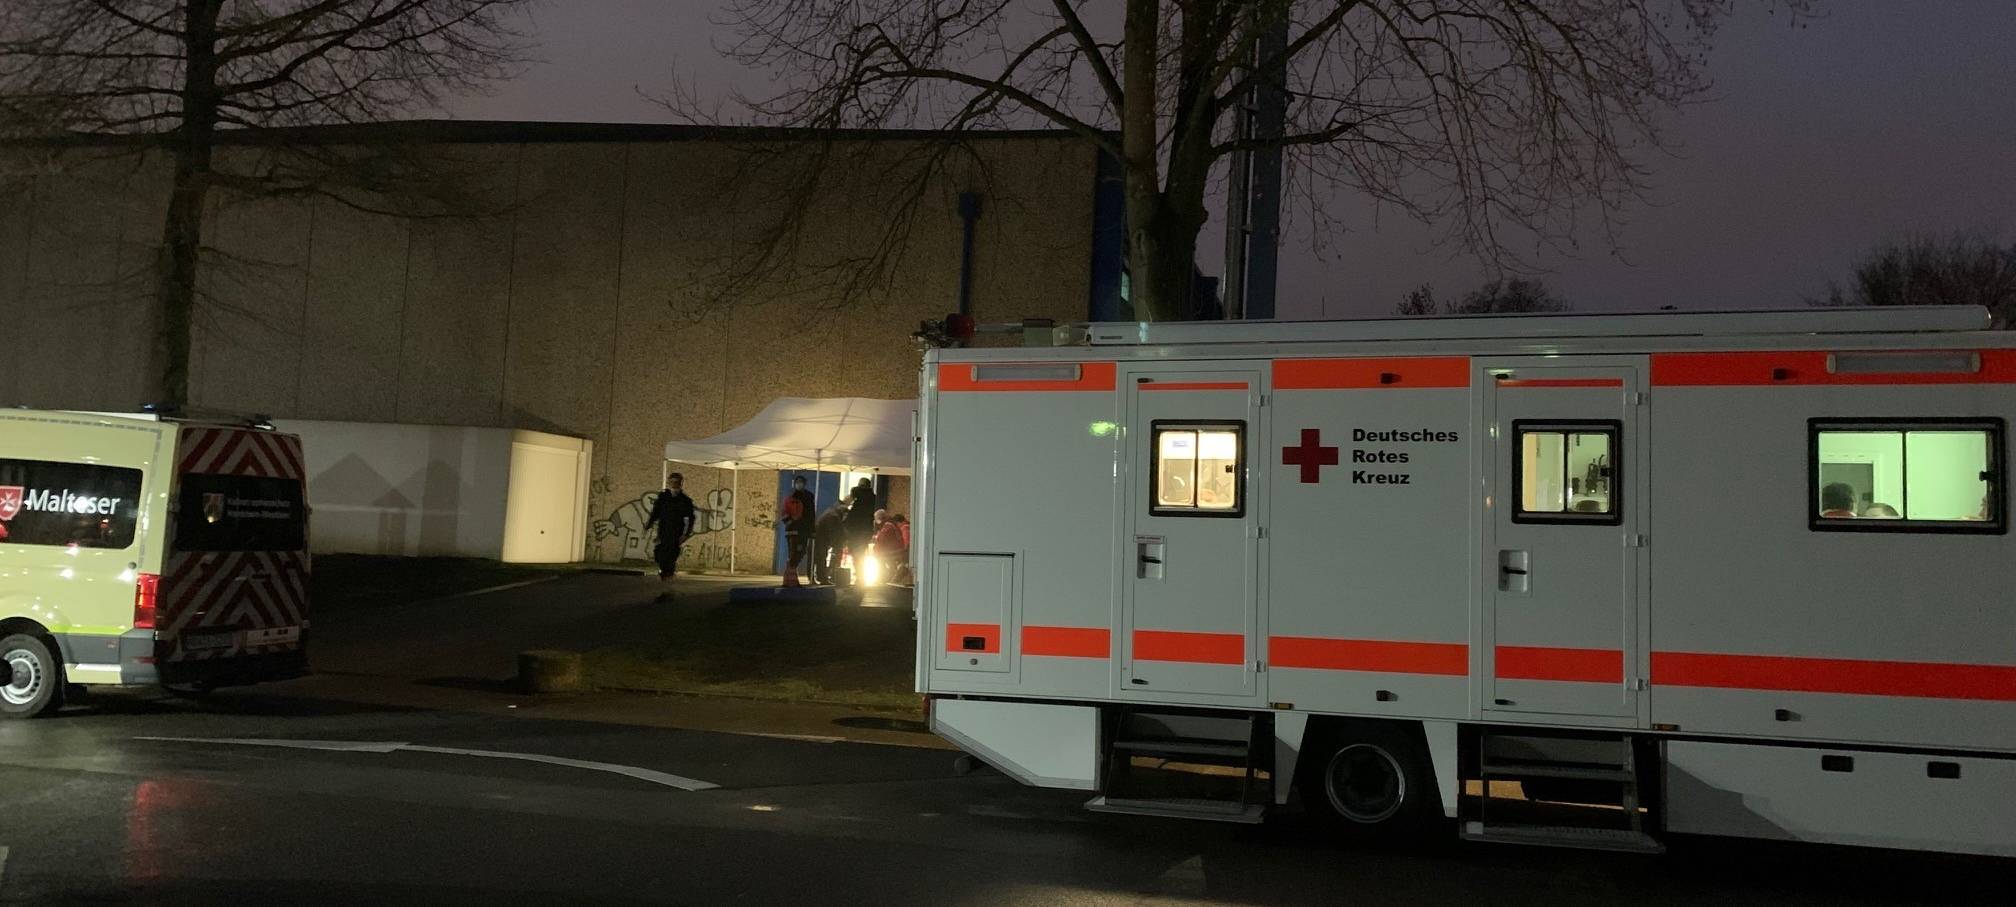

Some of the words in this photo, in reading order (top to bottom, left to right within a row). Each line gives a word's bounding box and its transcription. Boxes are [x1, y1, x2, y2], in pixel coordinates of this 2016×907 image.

[1352, 428, 1459, 442] Deutsches
[1352, 449, 1410, 463] Rotes
[1352, 470, 1411, 484] Kreuz
